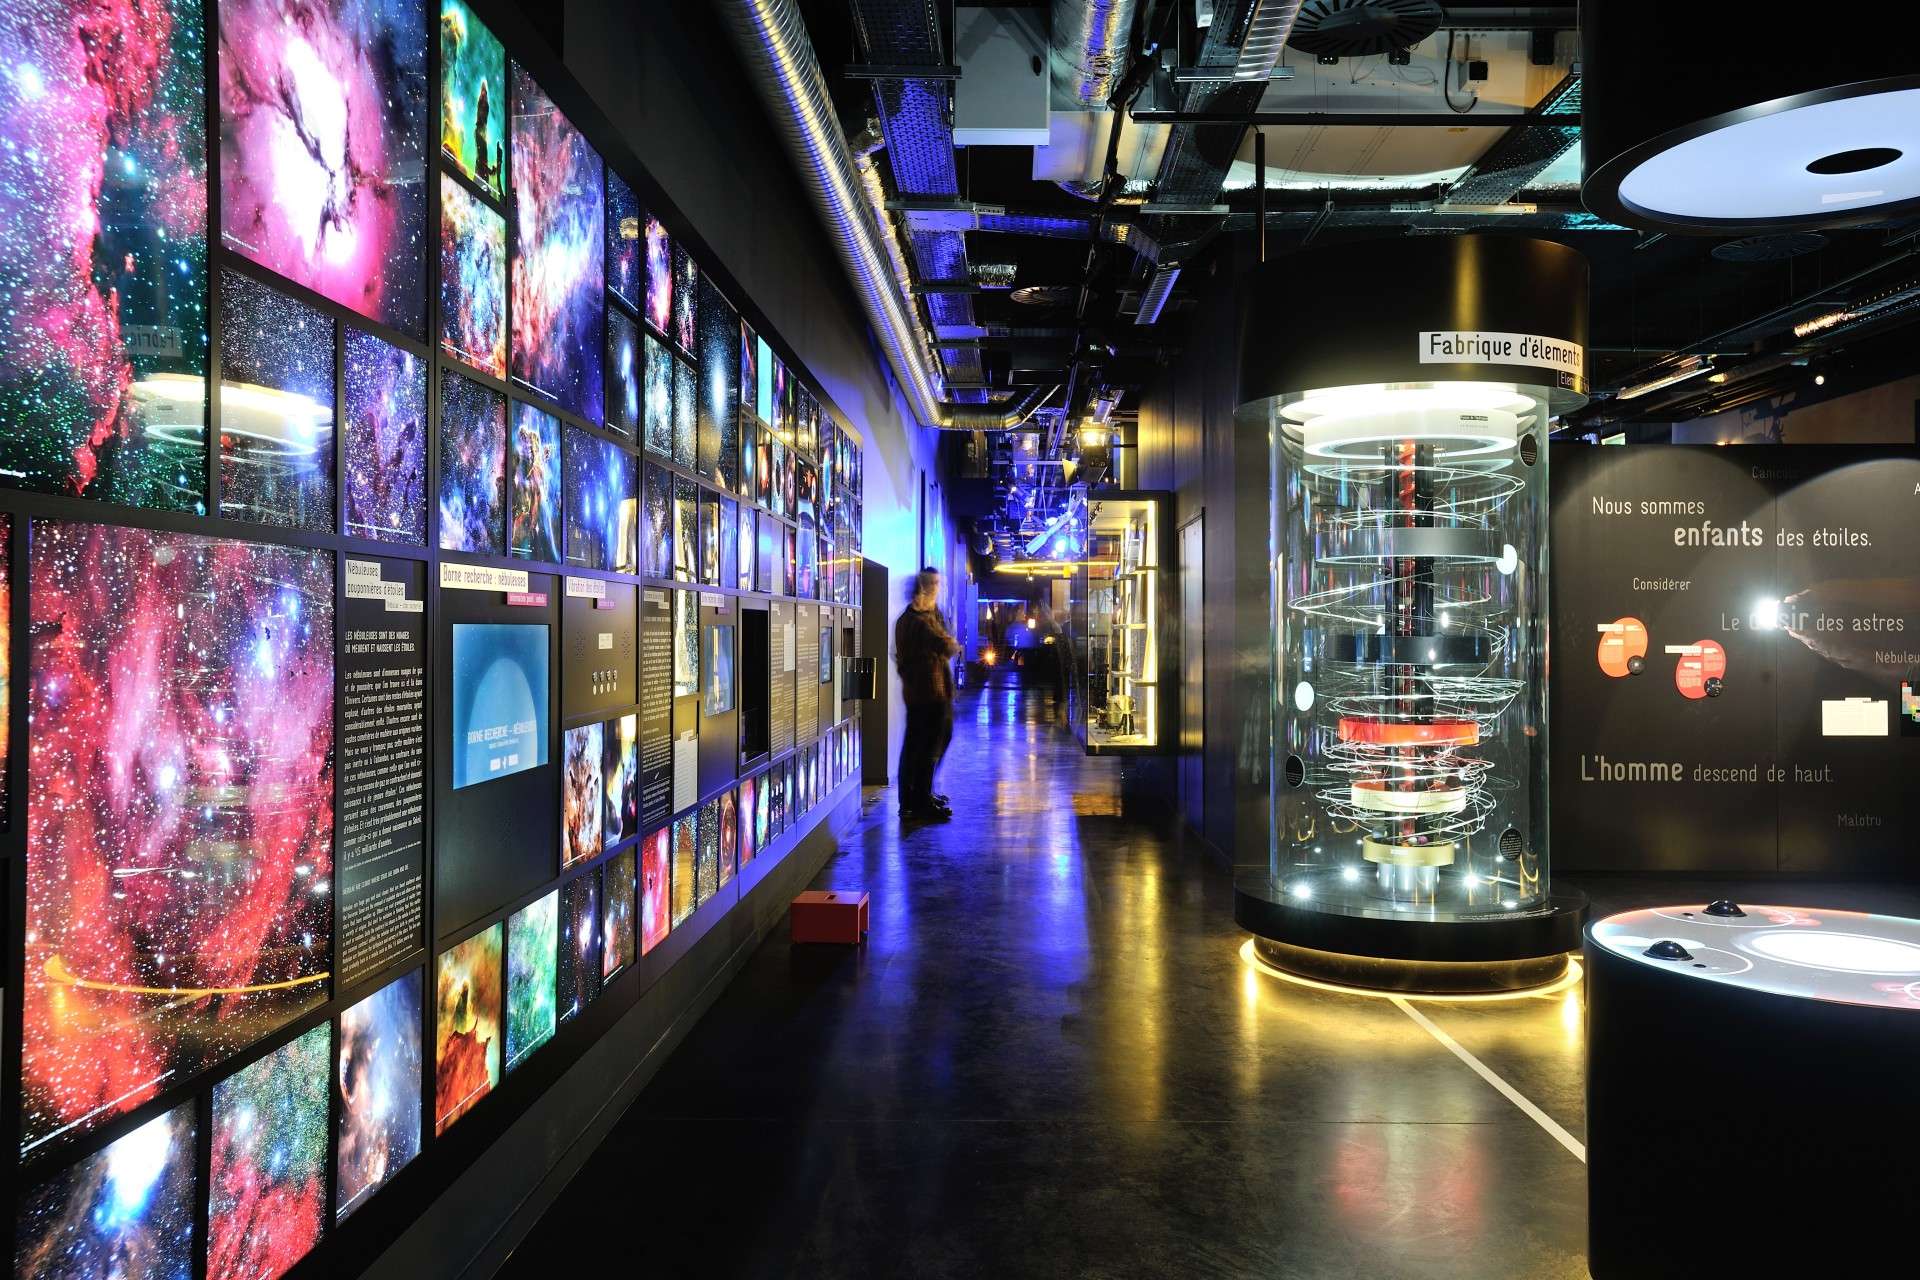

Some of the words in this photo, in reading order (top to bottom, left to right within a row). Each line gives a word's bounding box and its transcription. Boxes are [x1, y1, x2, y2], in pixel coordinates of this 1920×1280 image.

[1430, 334, 1512, 361] Fabrique
[1520, 336, 1582, 367] d'élements
[1592, 496, 1632, 514] Nous
[1640, 501, 1705, 514] sommes
[1674, 520, 1763, 546] enfants
[1776, 528, 1804, 546] des
[1812, 528, 1872, 546] étoiles.
[348, 562, 378, 577] Nébuleuses
[443, 564, 462, 582] Borne
[464, 567, 492, 585] recherche
[498, 571, 526, 588] nébuleuses
[348, 583, 382, 596] pouponnières
[1632, 578, 1692, 590] Considérer
[1722, 612, 1740, 631] Le
[1816, 612, 1844, 631] des
[1852, 613, 1904, 632] astres
[1875, 650, 1920, 664] Nébuleu
[1581, 755, 1684, 782] L'homme
[1694, 764, 1757, 782] descend
[1767, 764, 1786, 782] de
[1795, 764, 1834, 782] haut.
[1838, 814, 1882, 826] Malotru
